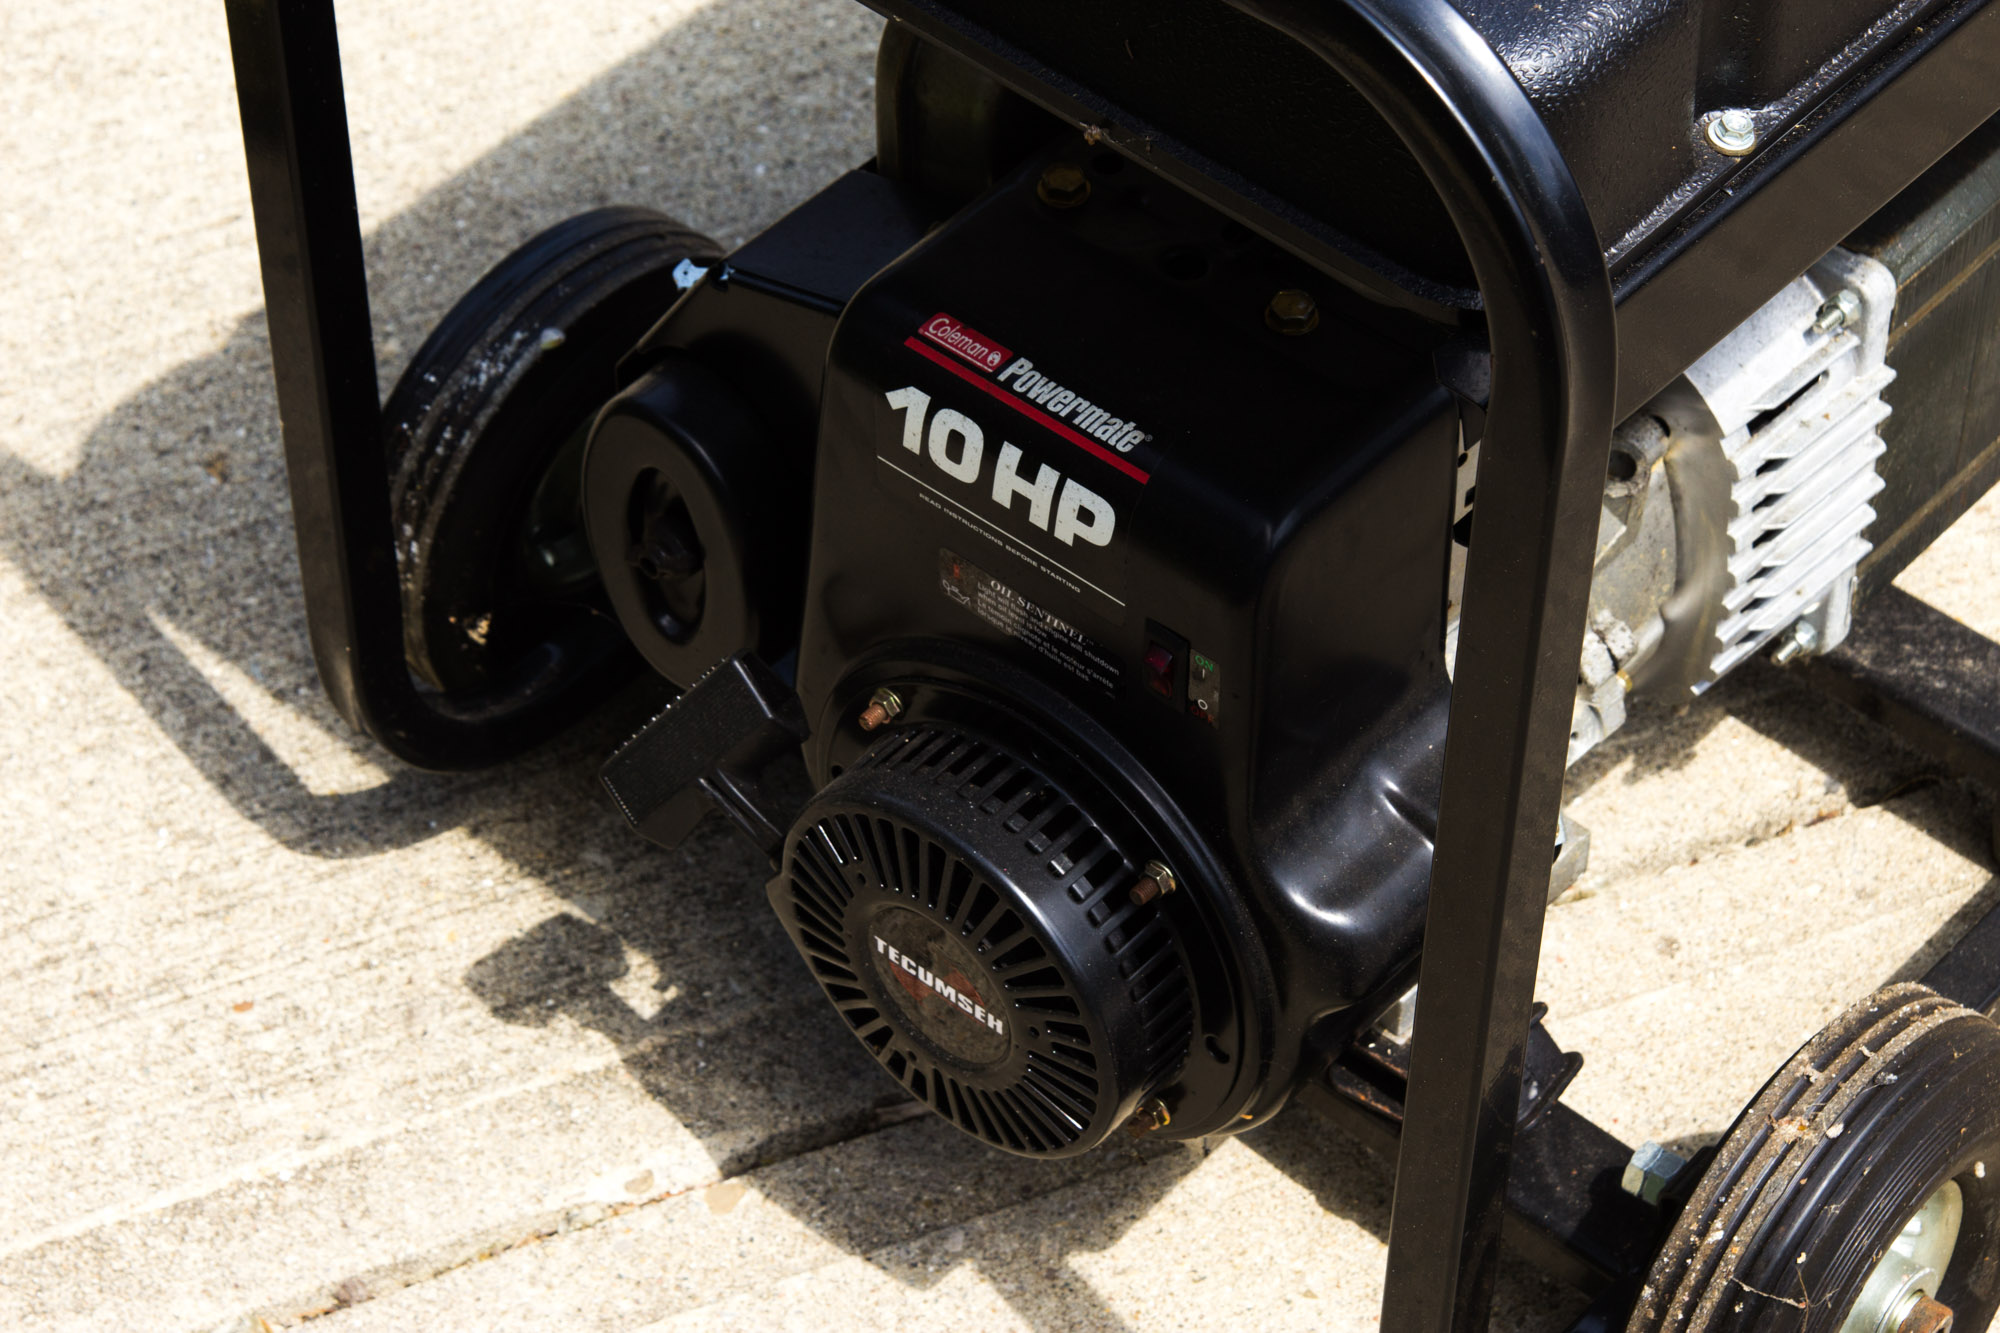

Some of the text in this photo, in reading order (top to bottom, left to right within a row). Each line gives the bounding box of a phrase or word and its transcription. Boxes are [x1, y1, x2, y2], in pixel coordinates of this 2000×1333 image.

[928, 318, 988, 360] Coleman
[885, 385, 1116, 547] 10 HP
[919, 491, 1080, 594] READ INSTRUCTIONS BEFORE STARTING
[990, 580, 1014, 601] OIL
[1195, 655, 1213, 672] ON
[874, 935, 1003, 1035] TECUMSEH
